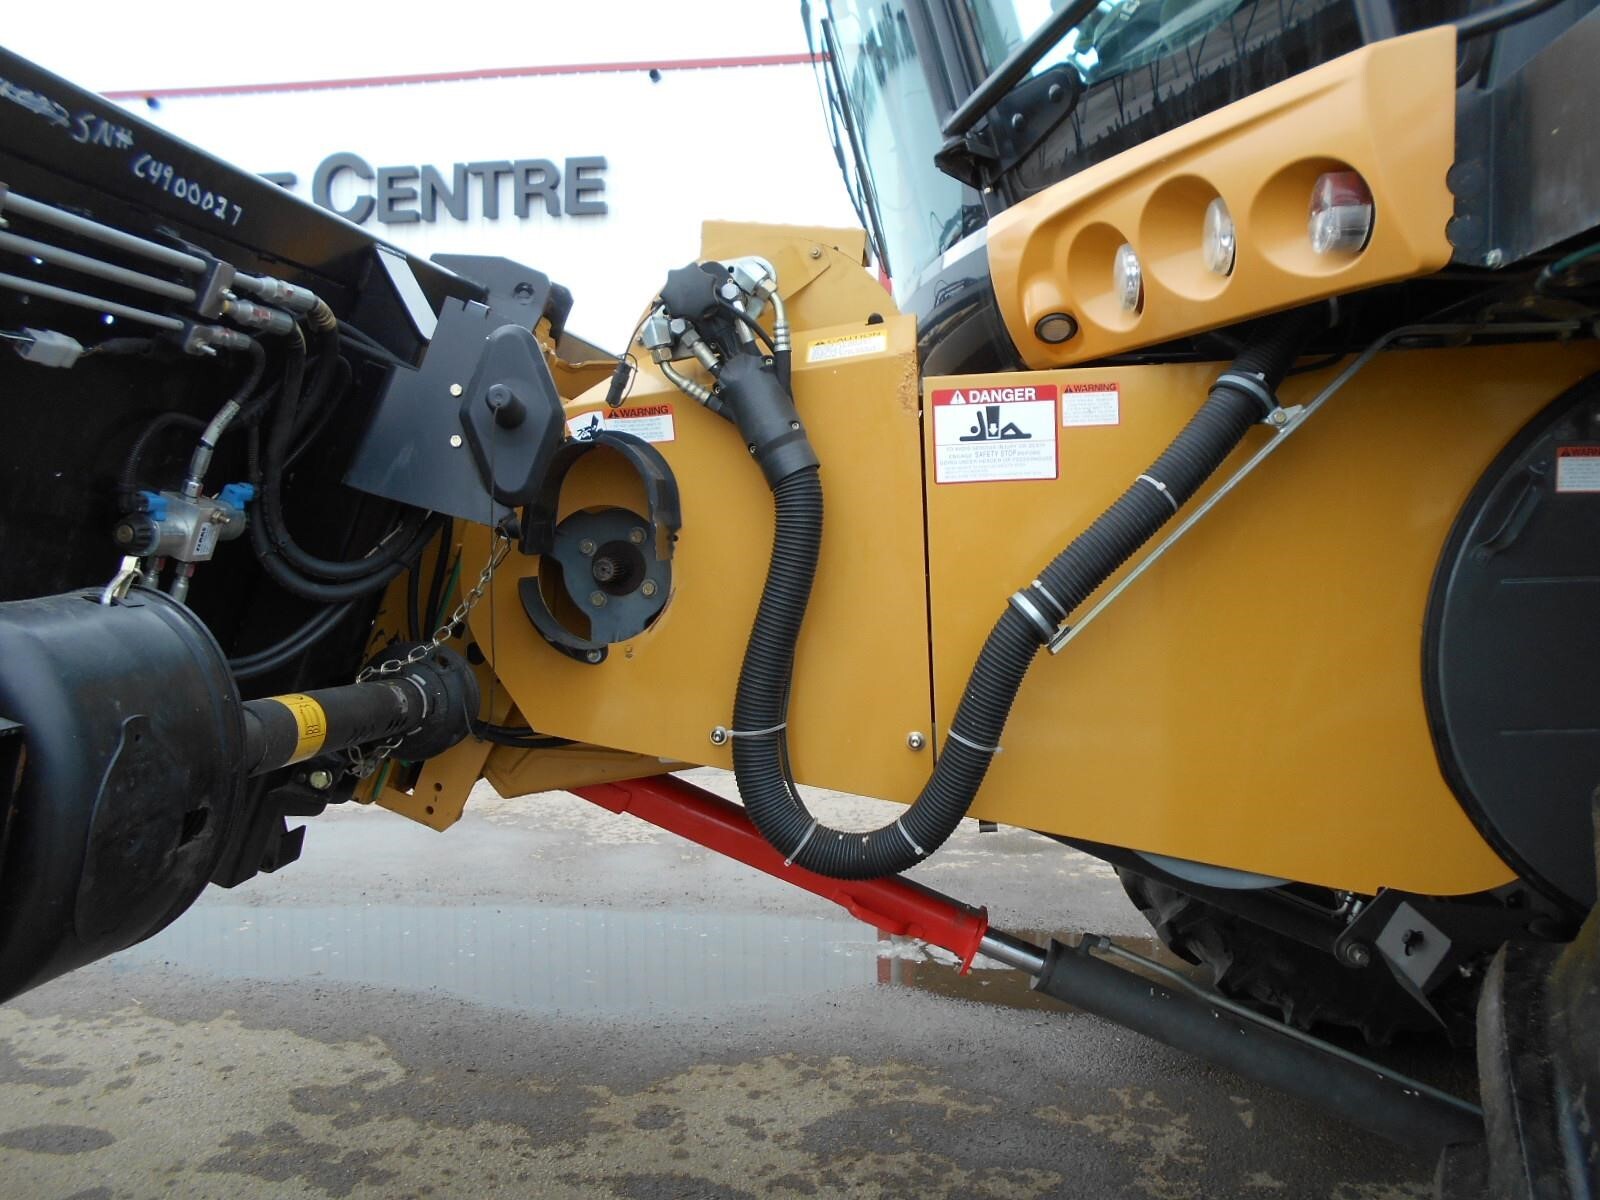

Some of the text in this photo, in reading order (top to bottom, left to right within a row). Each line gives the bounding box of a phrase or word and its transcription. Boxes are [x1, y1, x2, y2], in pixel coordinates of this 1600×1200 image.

[312, 152, 608, 225] CENTRE
[1073, 384, 1117, 393] WARNING
[969, 387, 1036, 404] DANGER
[620, 405, 669, 418] WARNING
[975, 450, 999, 458] SAFETY
[1000, 449, 1017, 457] STOP
